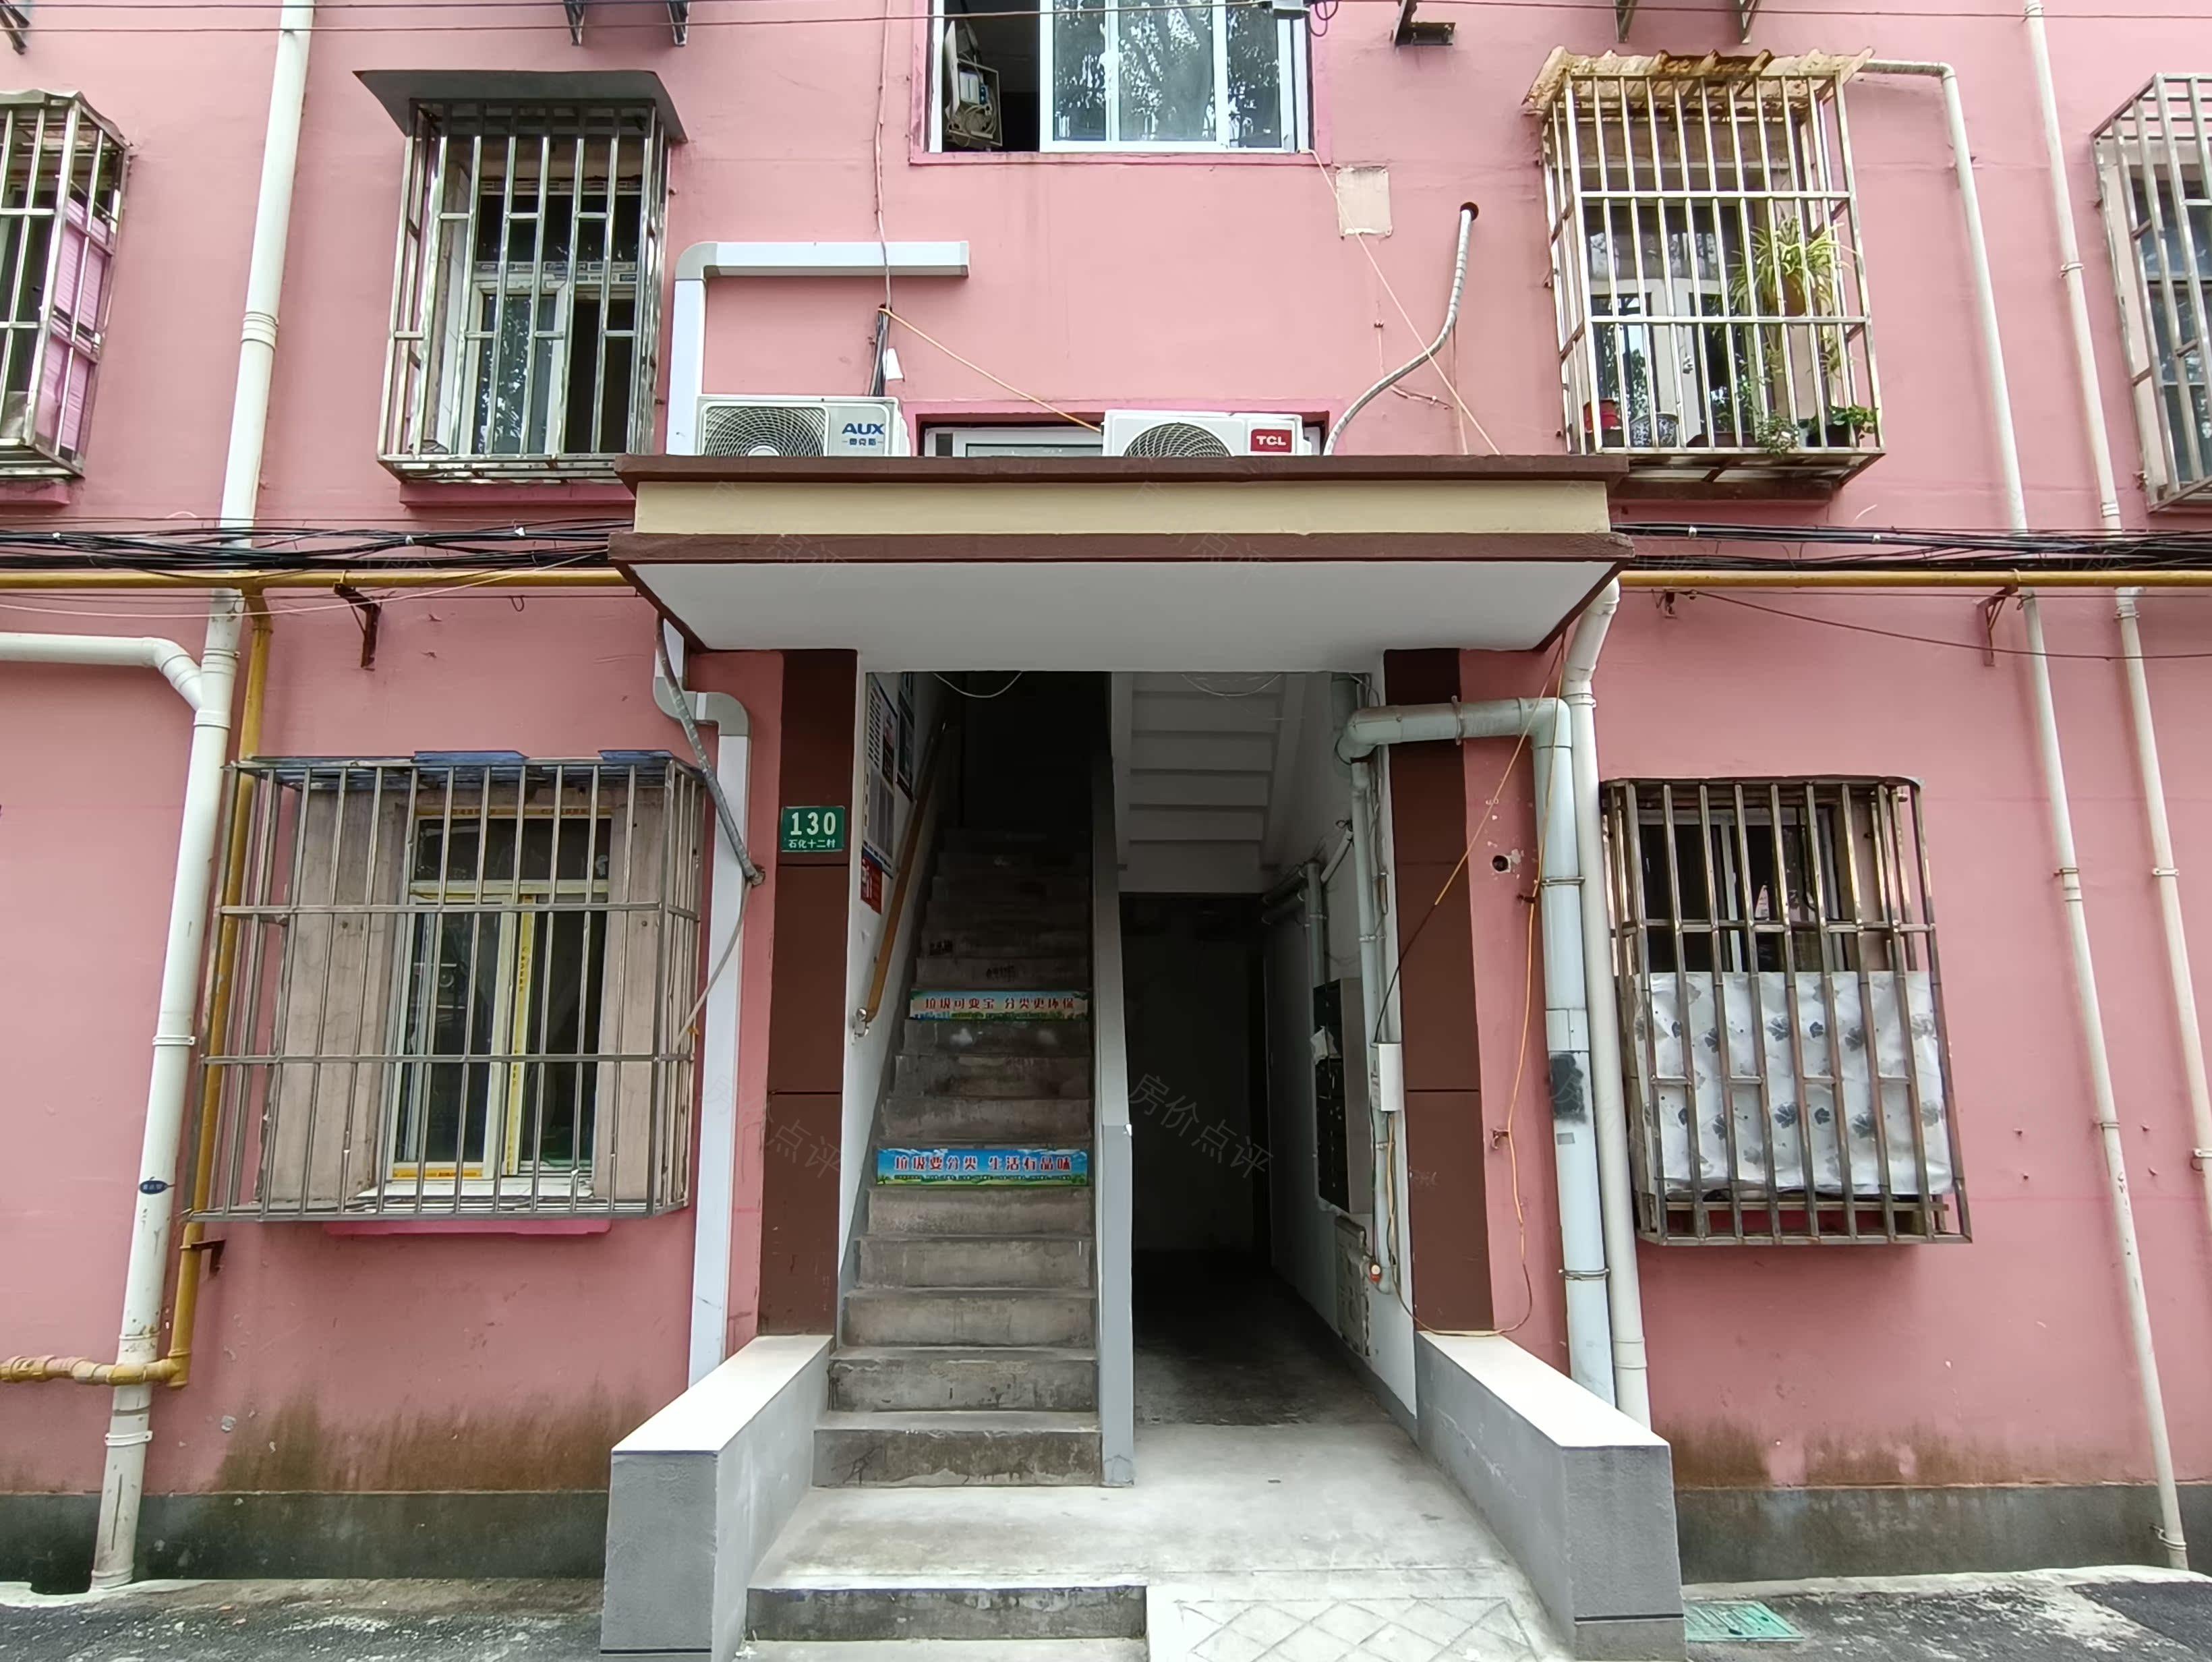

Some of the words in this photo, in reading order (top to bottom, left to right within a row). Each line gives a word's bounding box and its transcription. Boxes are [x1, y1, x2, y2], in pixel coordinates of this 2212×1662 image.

[842, 423, 885, 435] AUX
[1256, 435, 1287, 446] TCL
[790, 811, 836, 836] 130
[788, 838, 836, 849] 石化十二村
[925, 998, 995, 1010] 垃圾可变宝
[1004, 998, 1074, 1010] 分类更环保
[895, 1155, 978, 1171] 垃圾要分类
[989, 1155, 1072, 1171] 生活有品味
